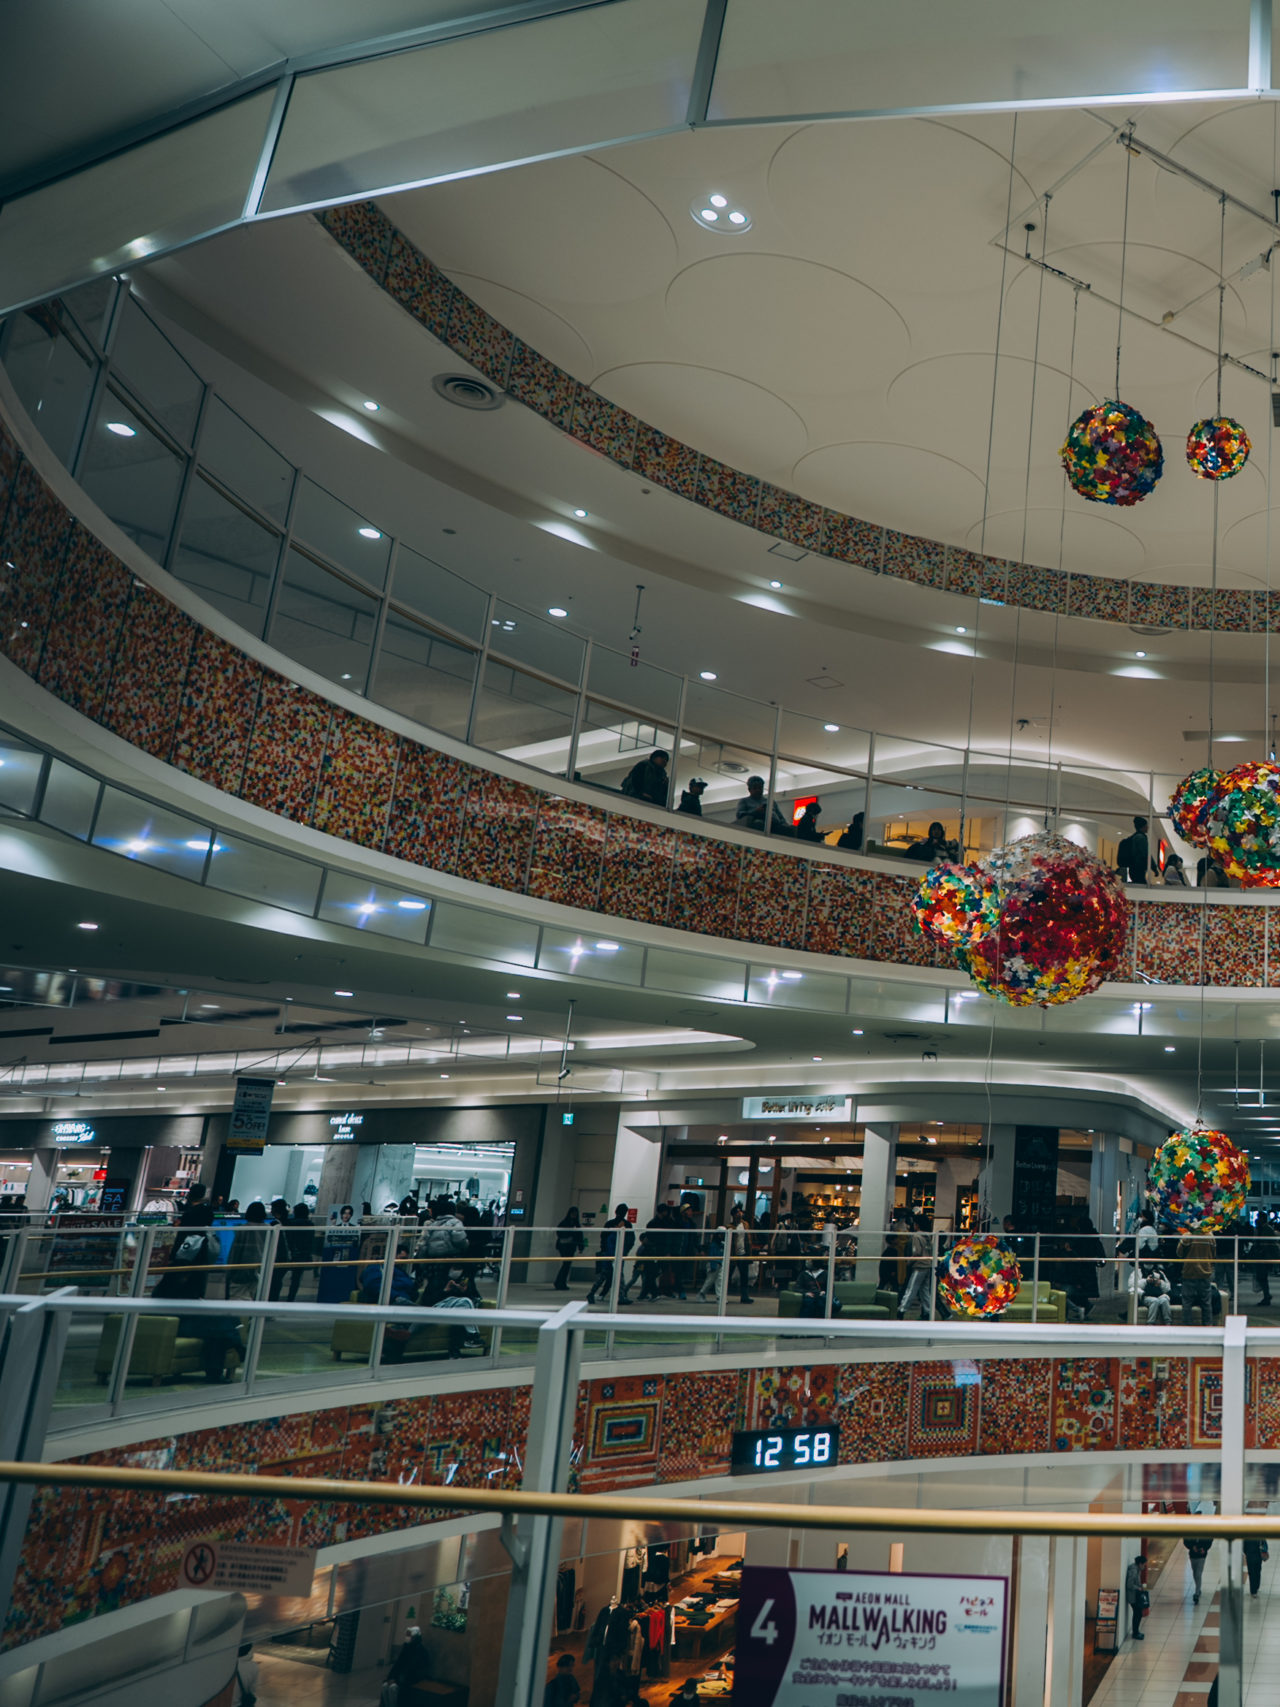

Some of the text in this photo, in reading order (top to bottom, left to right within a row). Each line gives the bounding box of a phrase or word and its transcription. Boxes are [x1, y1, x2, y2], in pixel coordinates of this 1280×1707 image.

[755, 1432, 830, 1466] 12 58
[854, 1592, 881, 1604] AEON
[884, 1593, 911, 1606] MALL
[750, 1599, 778, 1645] 4
[809, 1604, 947, 1650] MALLWALKING
